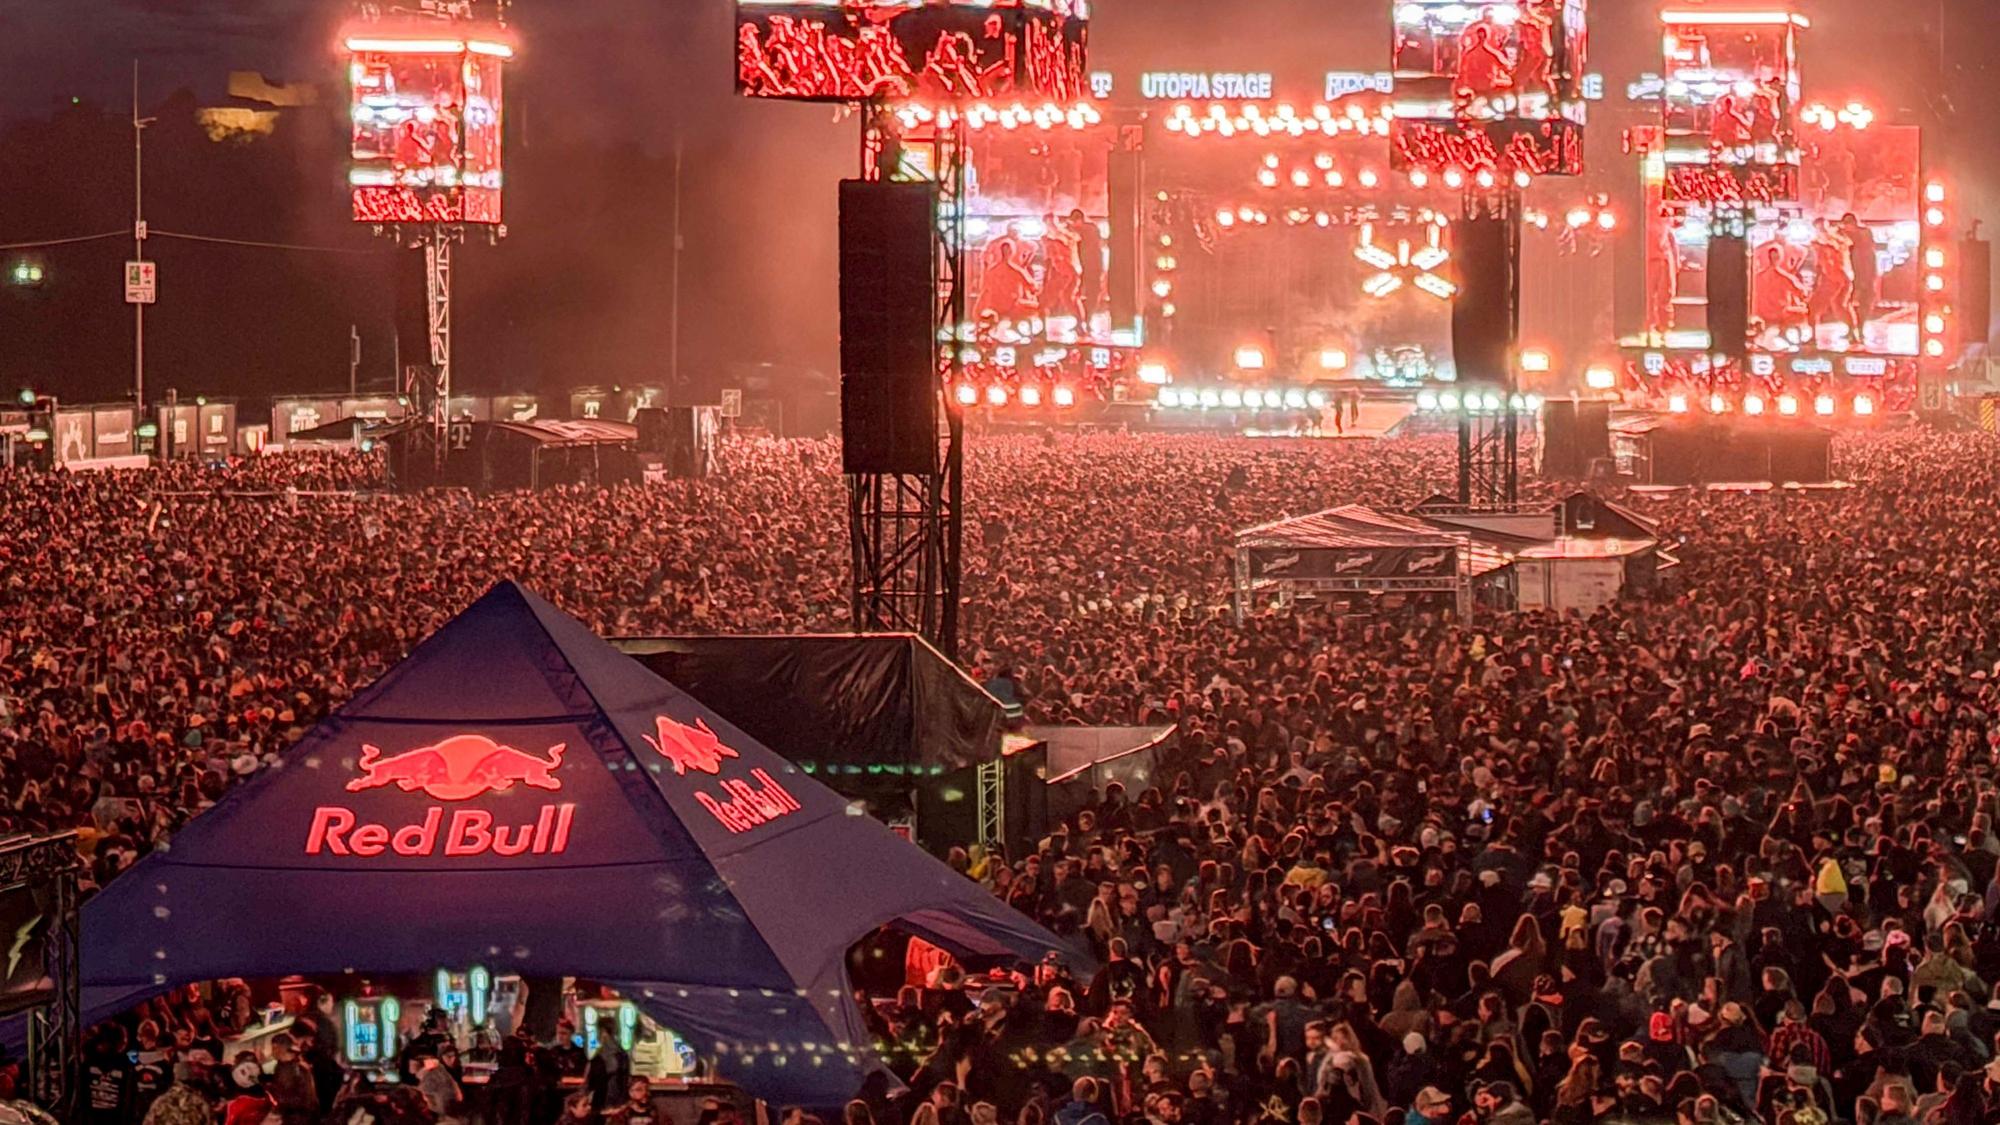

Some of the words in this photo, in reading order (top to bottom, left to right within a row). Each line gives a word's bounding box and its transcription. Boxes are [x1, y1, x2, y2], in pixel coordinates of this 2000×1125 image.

[1142, 73, 1210, 98] UTOPIA
[1212, 73, 1272, 98] STAGE
[694, 780, 766, 833] Red
[729, 768, 801, 820] Bull
[306, 806, 443, 856] Red
[445, 803, 576, 856] Bull
